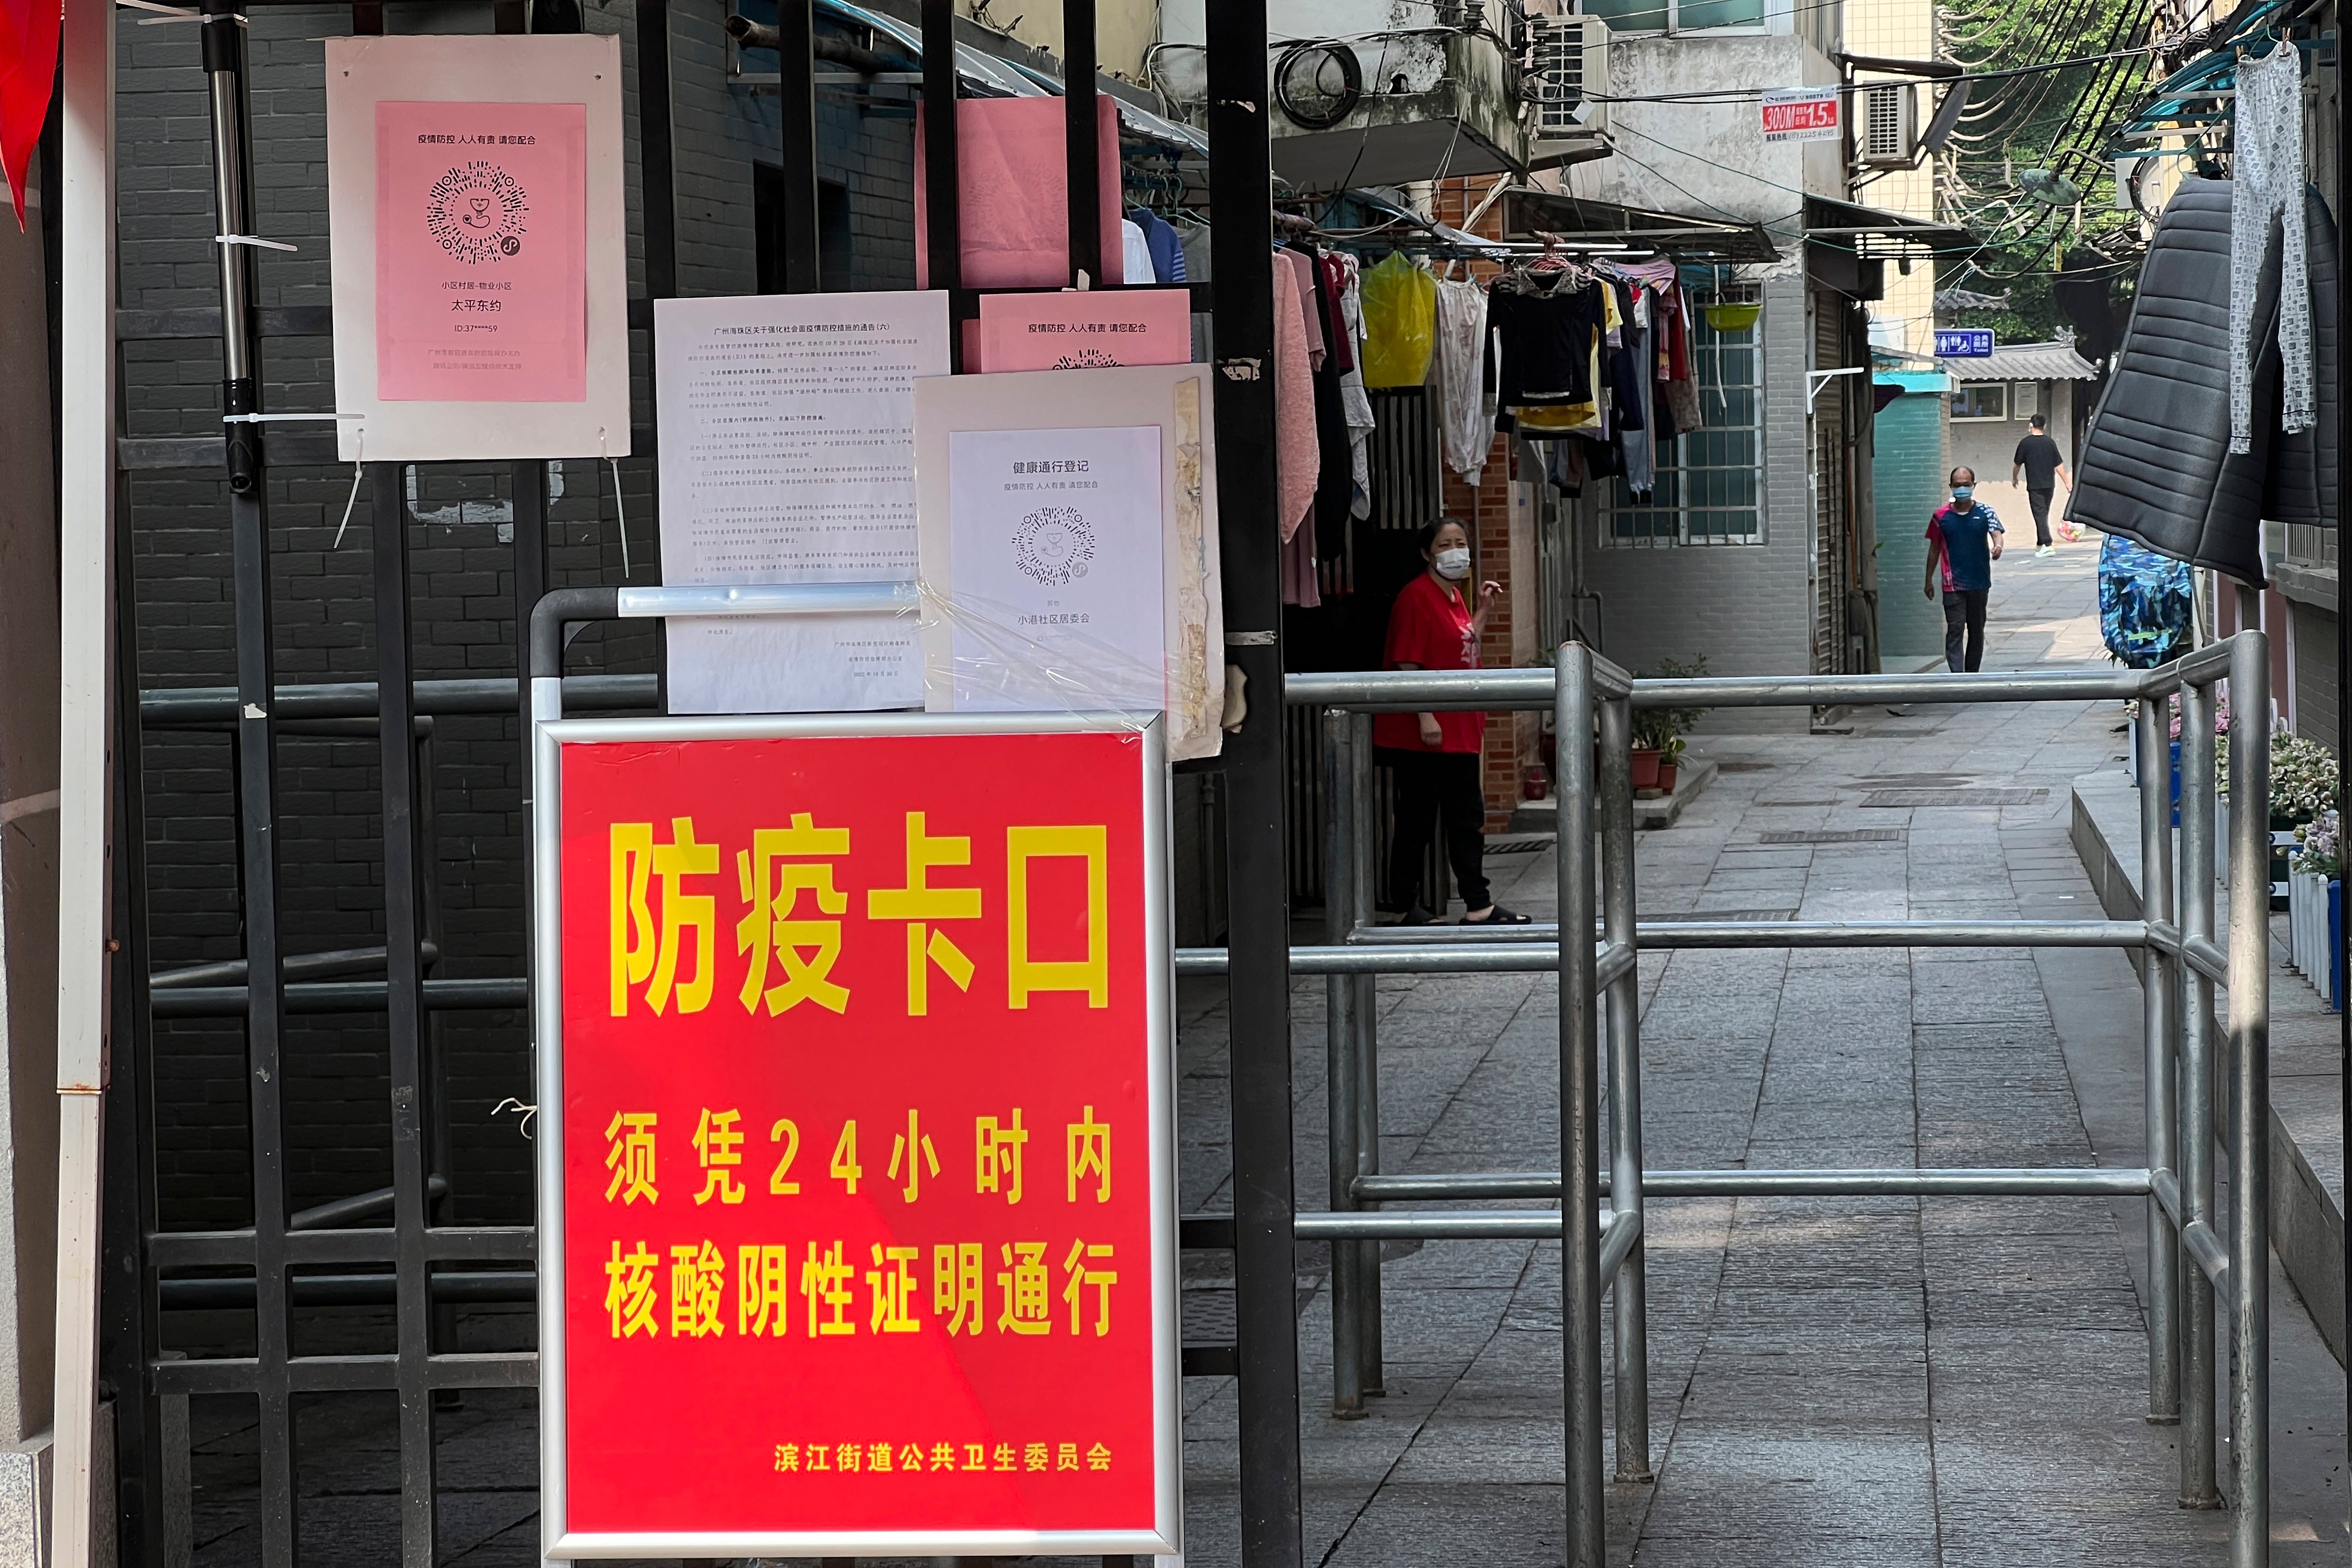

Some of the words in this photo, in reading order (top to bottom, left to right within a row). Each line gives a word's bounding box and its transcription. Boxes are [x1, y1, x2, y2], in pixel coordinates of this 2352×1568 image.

[1765, 105, 1796, 131] 300M
[1807, 103, 1828, 127] 1.5
[418, 134, 455, 145] 疫情防控
[458, 134, 495, 145] 人人有责
[499, 134, 536, 145] 请您配合
[442, 281, 512, 290] 小区村居-物业小区
[451, 299, 501, 312] 太平东约
[1028, 323, 1065, 333] 疫情防控
[1068, 323, 1105, 333] 人人有责
[1109, 323, 1147, 333] 请您配合
[1013, 460, 1089, 474] 健康通行登记
[1004, 481, 1033, 491] 疫情防控
[1036, 481, 1065, 490] 人人有责
[1069, 480, 1098, 490] 请您配合
[1018, 613, 1090, 625] 小港社区居委会
[610, 811, 1109, 1018] 防疫卡口
[604, 1105, 1111, 1206] 须凭24小时内
[604, 1238, 1118, 1338] 核酸阴性证明通行
[774, 1442, 1112, 1472] 滨江街道公共卫生委员会
